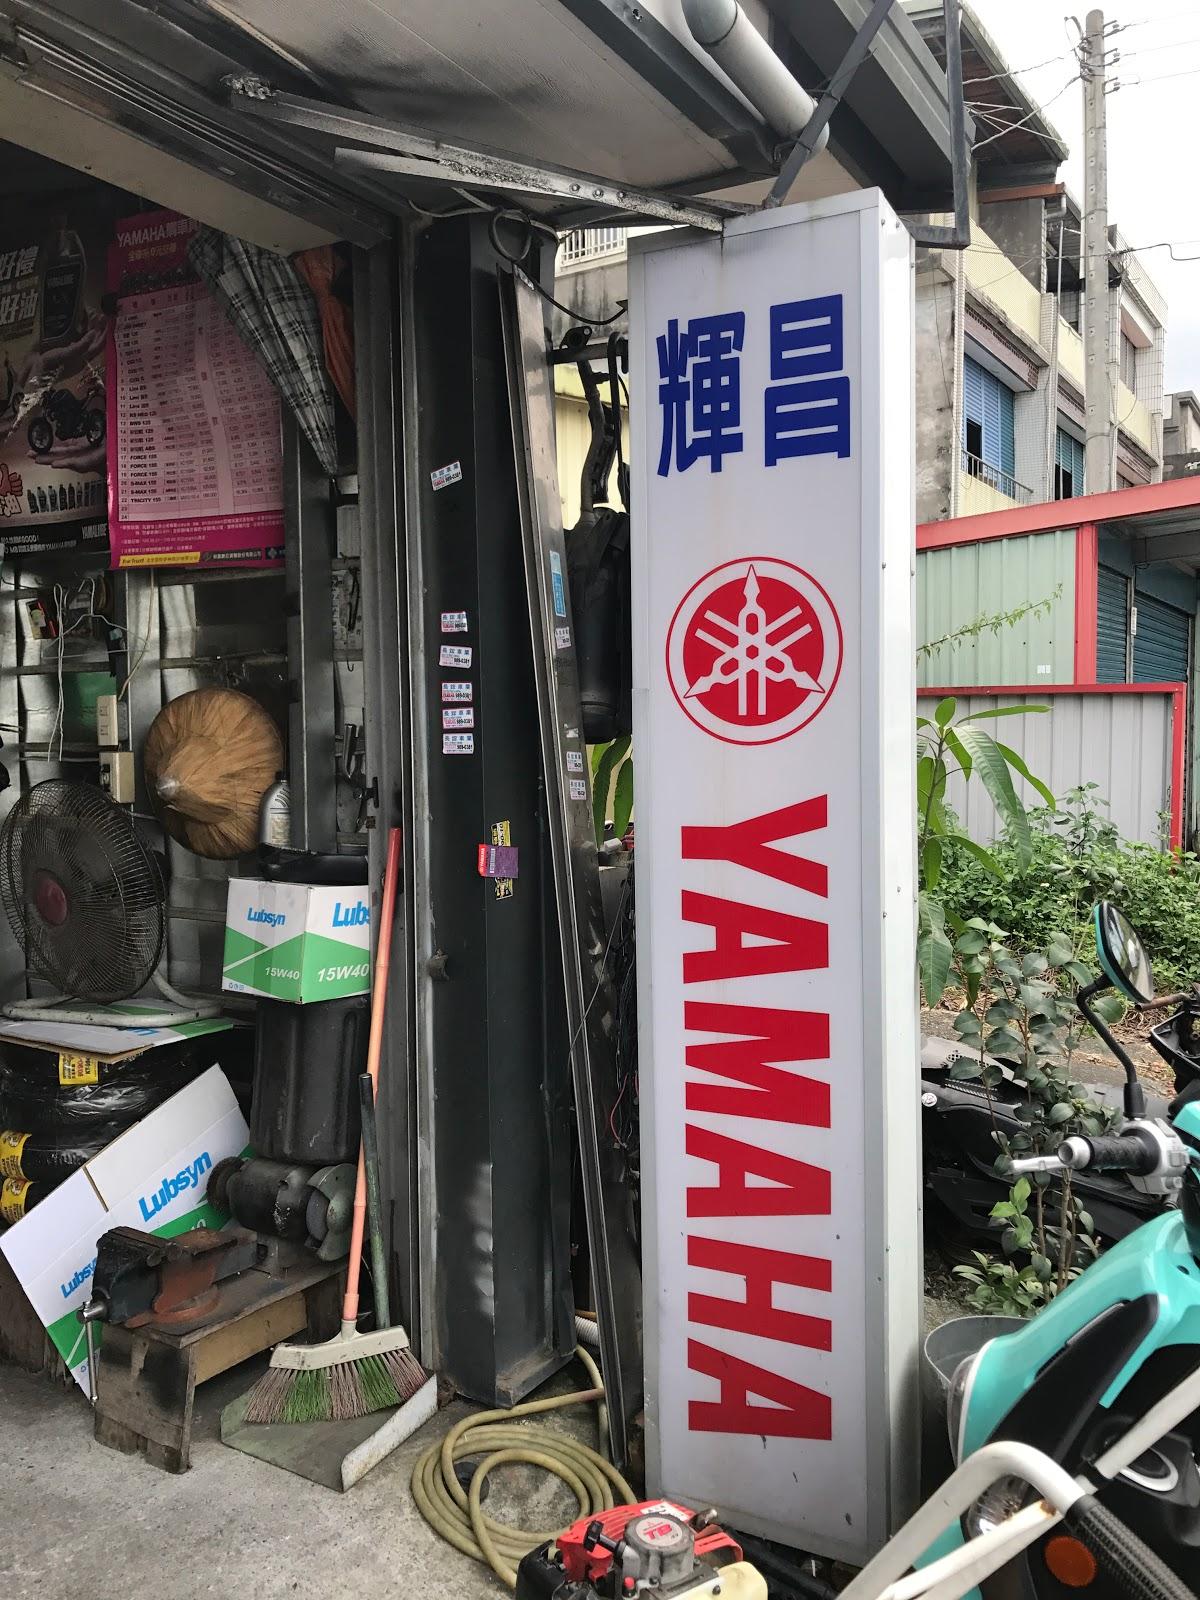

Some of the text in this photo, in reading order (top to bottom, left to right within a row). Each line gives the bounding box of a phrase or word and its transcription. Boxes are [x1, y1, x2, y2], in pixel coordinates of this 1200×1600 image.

[247, 907, 286, 927] Lubsyn
[265, 967, 300, 980] 15W40
[317, 963, 369, 982] 15W40
[681, 794, 832, 1440] YAMAHA
[138, 1151, 213, 1222] Lubsyn
